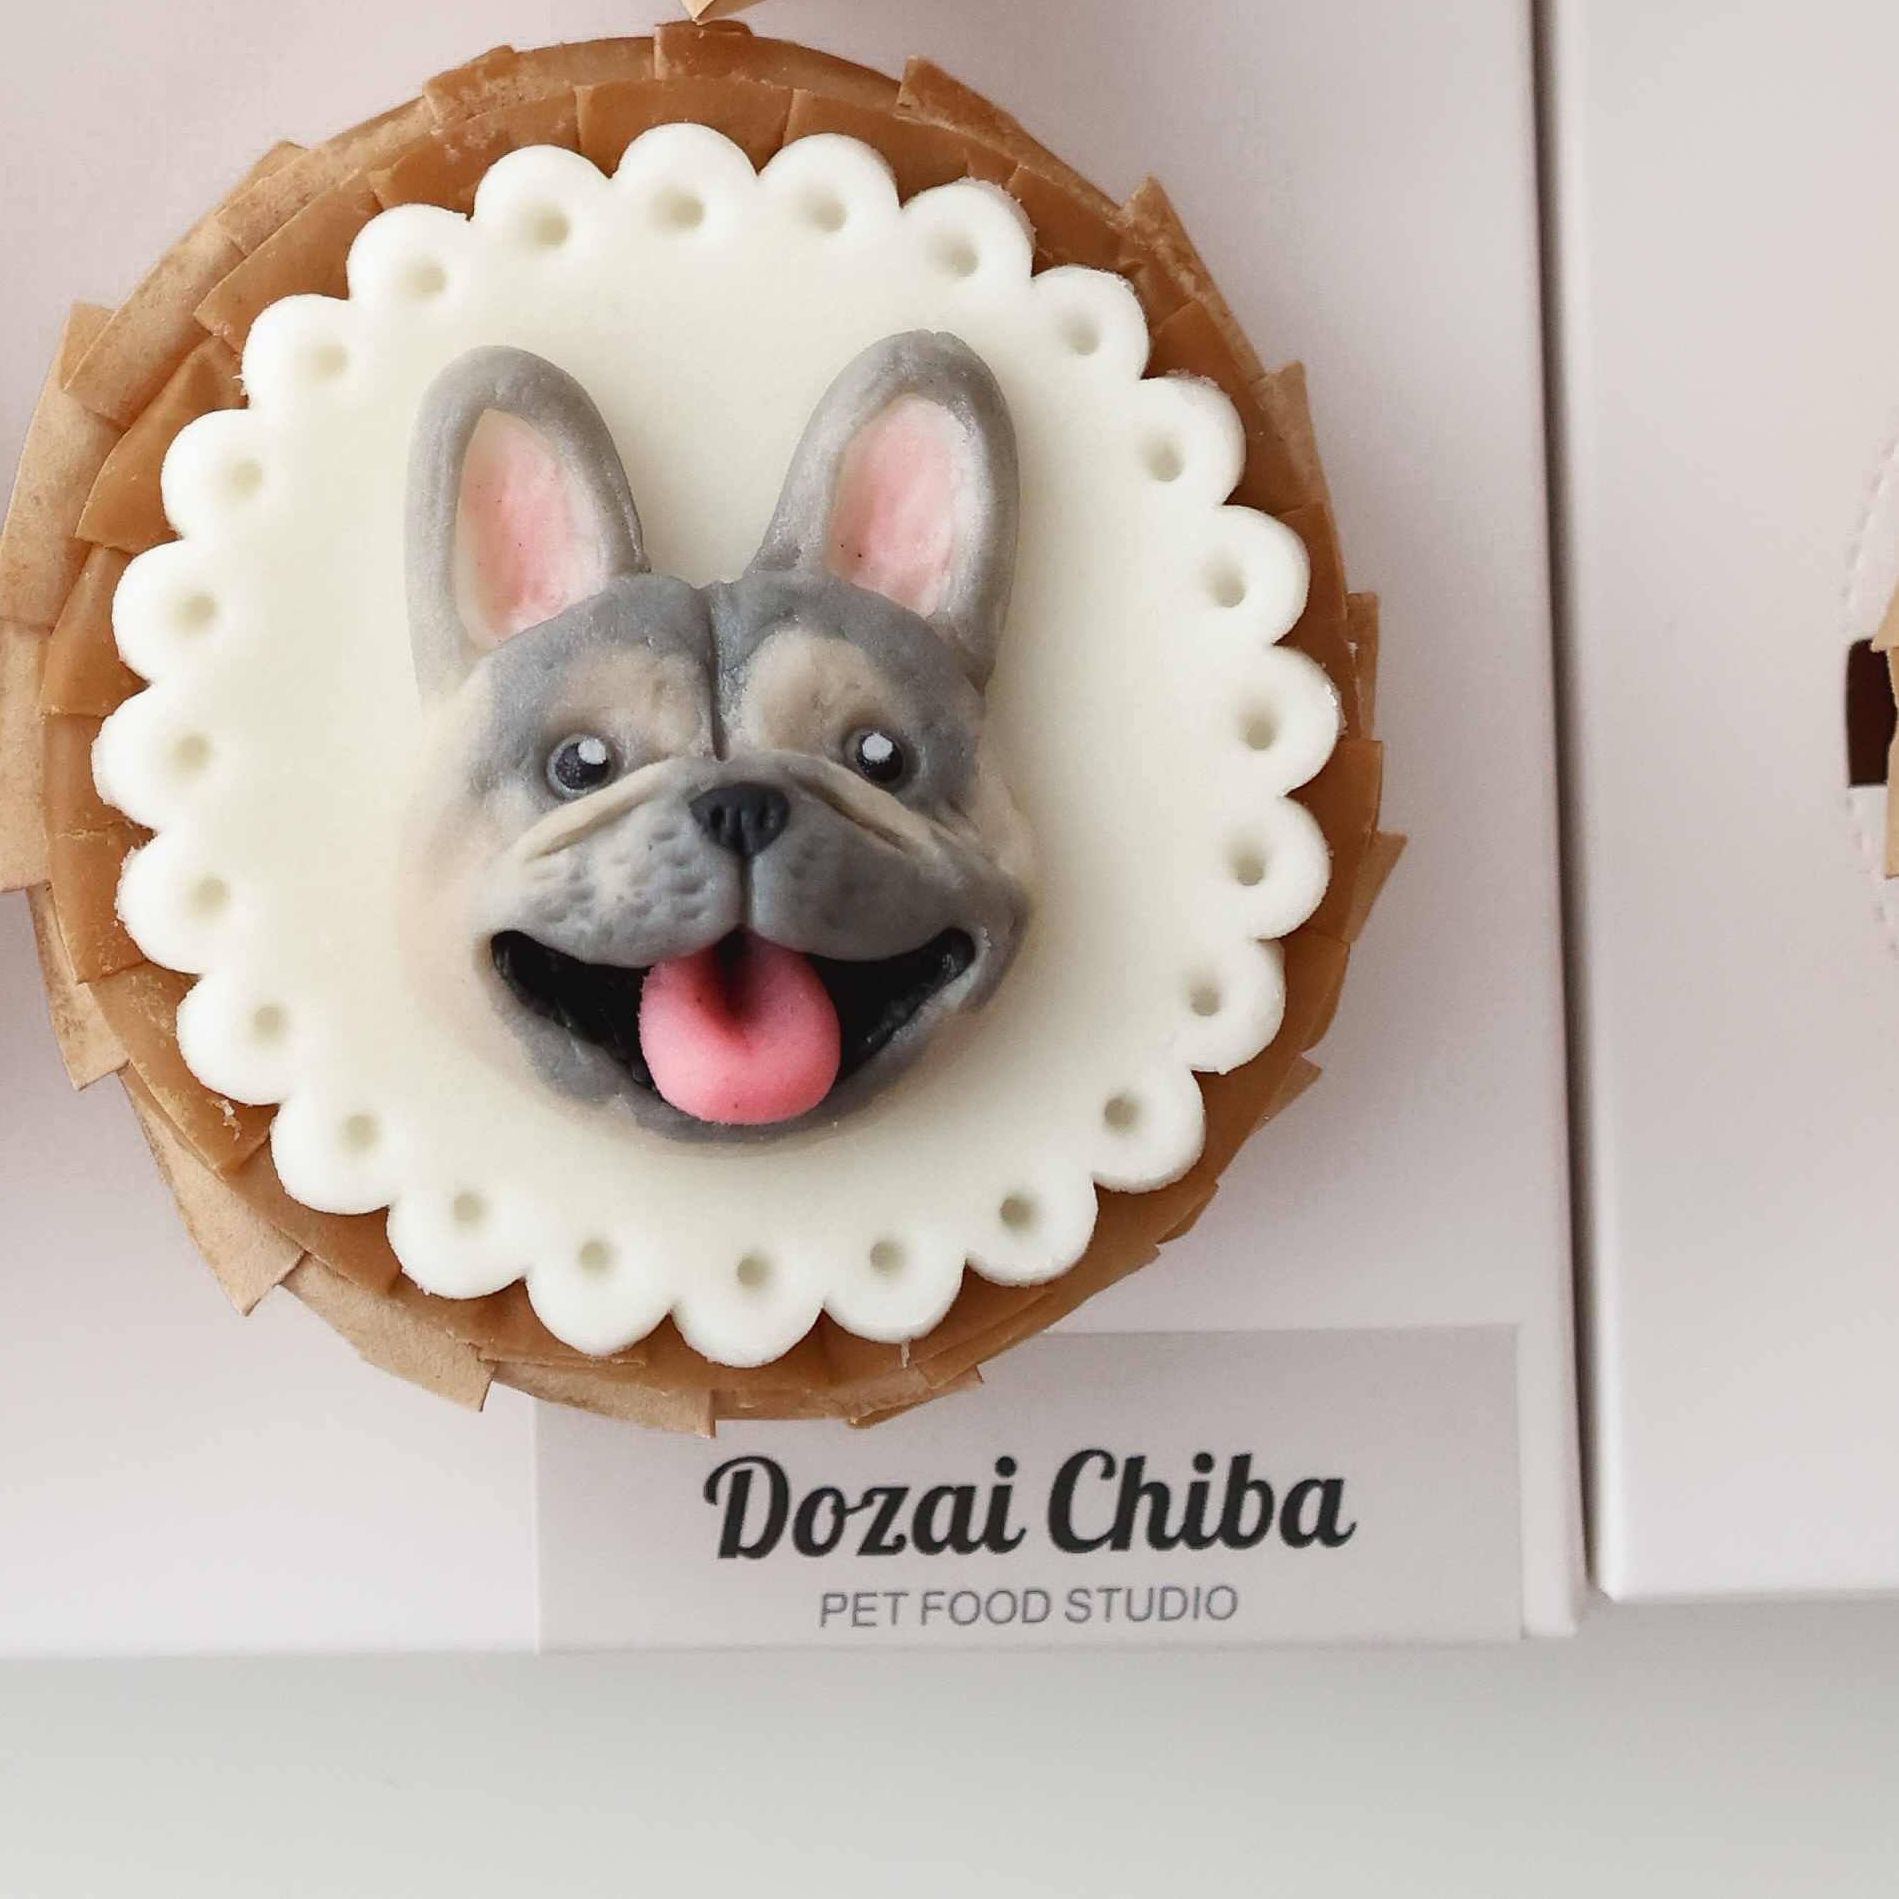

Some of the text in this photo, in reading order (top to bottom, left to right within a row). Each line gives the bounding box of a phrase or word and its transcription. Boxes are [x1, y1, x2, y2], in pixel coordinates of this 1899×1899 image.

[703, 1448, 1357, 1560] Dozai Chiba
[820, 1584, 1238, 1627] PET FOOD STUDIO
